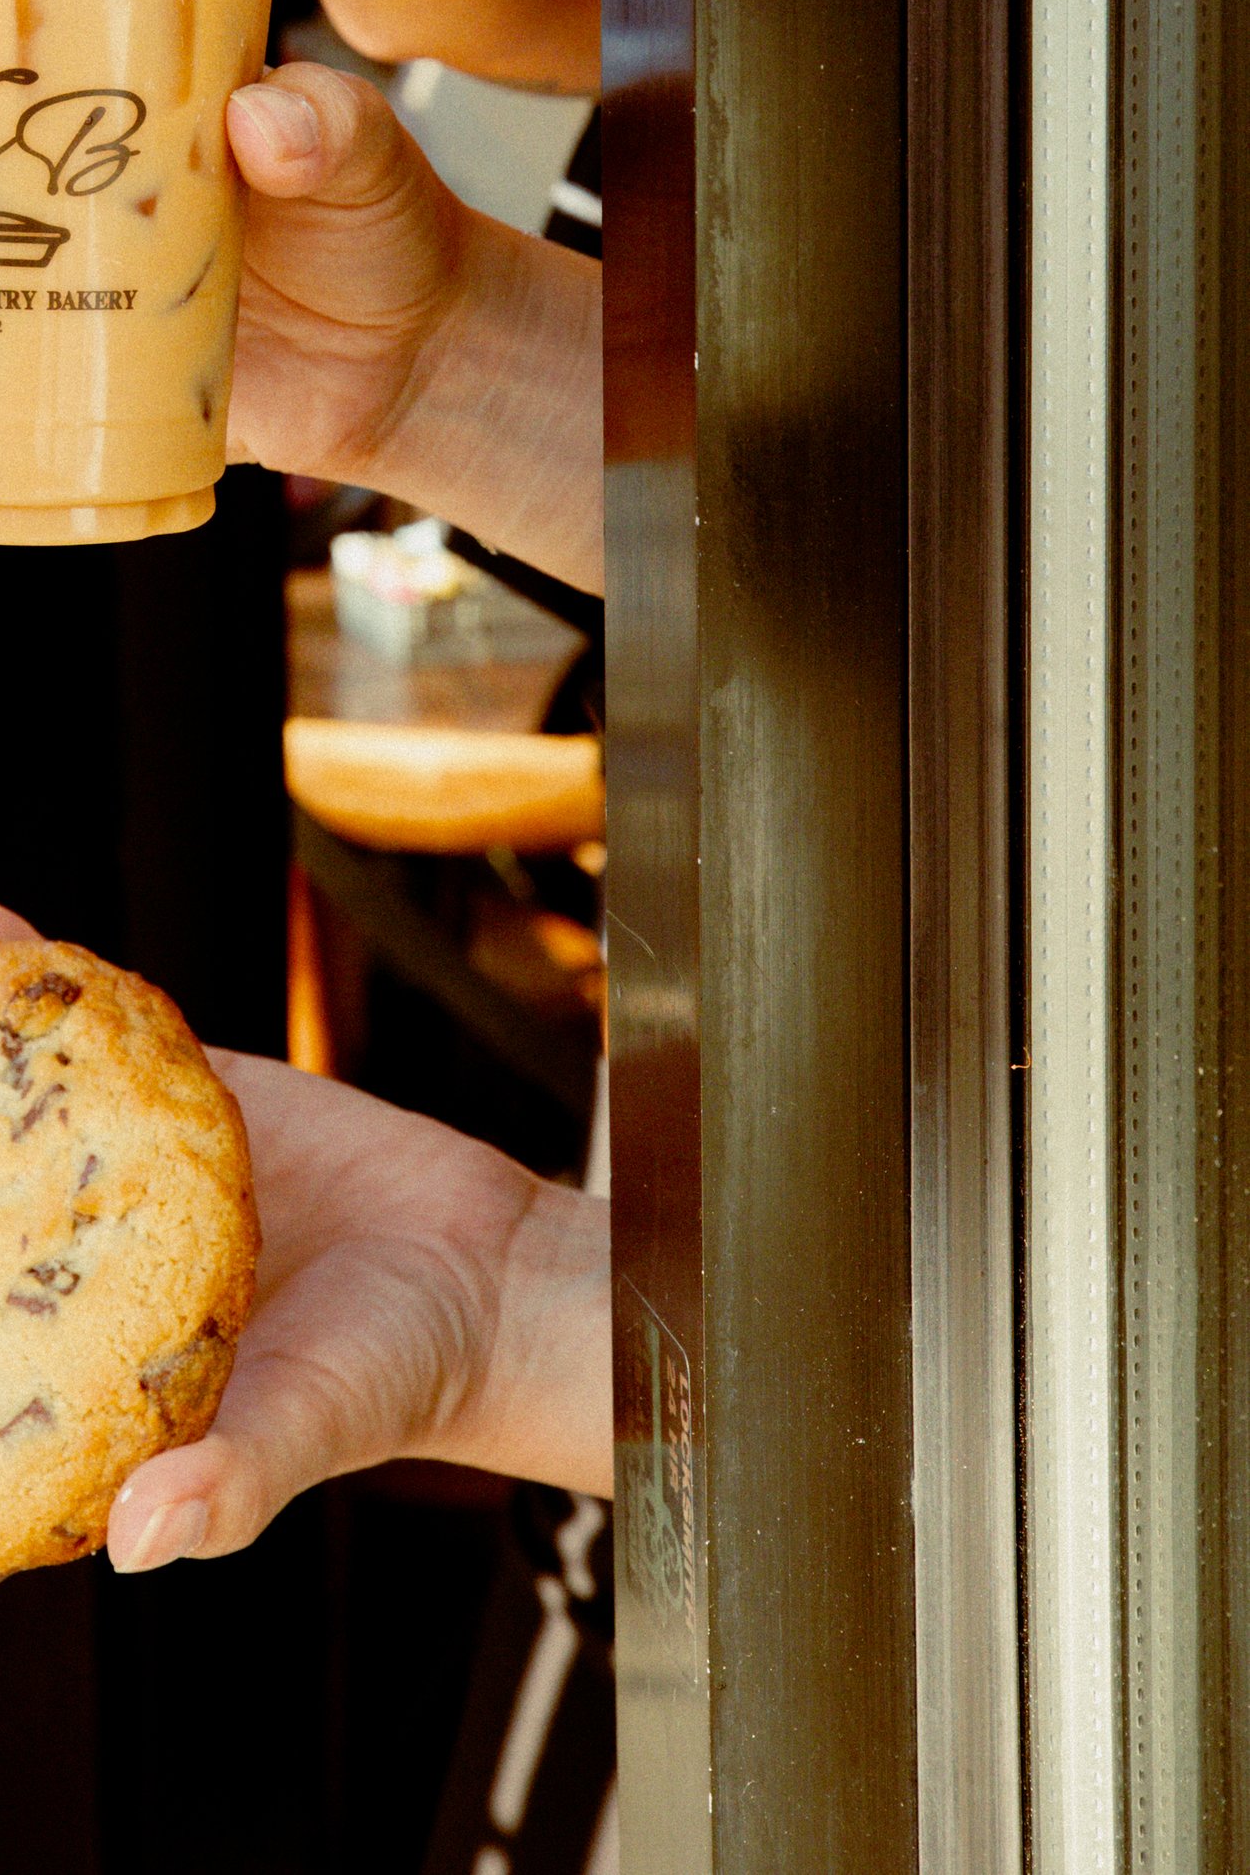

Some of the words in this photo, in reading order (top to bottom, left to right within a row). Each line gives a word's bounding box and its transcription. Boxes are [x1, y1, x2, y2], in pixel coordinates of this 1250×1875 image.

[46, 289, 138, 310] BAKERY
[667, 1353, 677, 1417] 24
[668, 1427, 680, 1494] HR
[679, 1372, 695, 1634] LOCKSMITH
